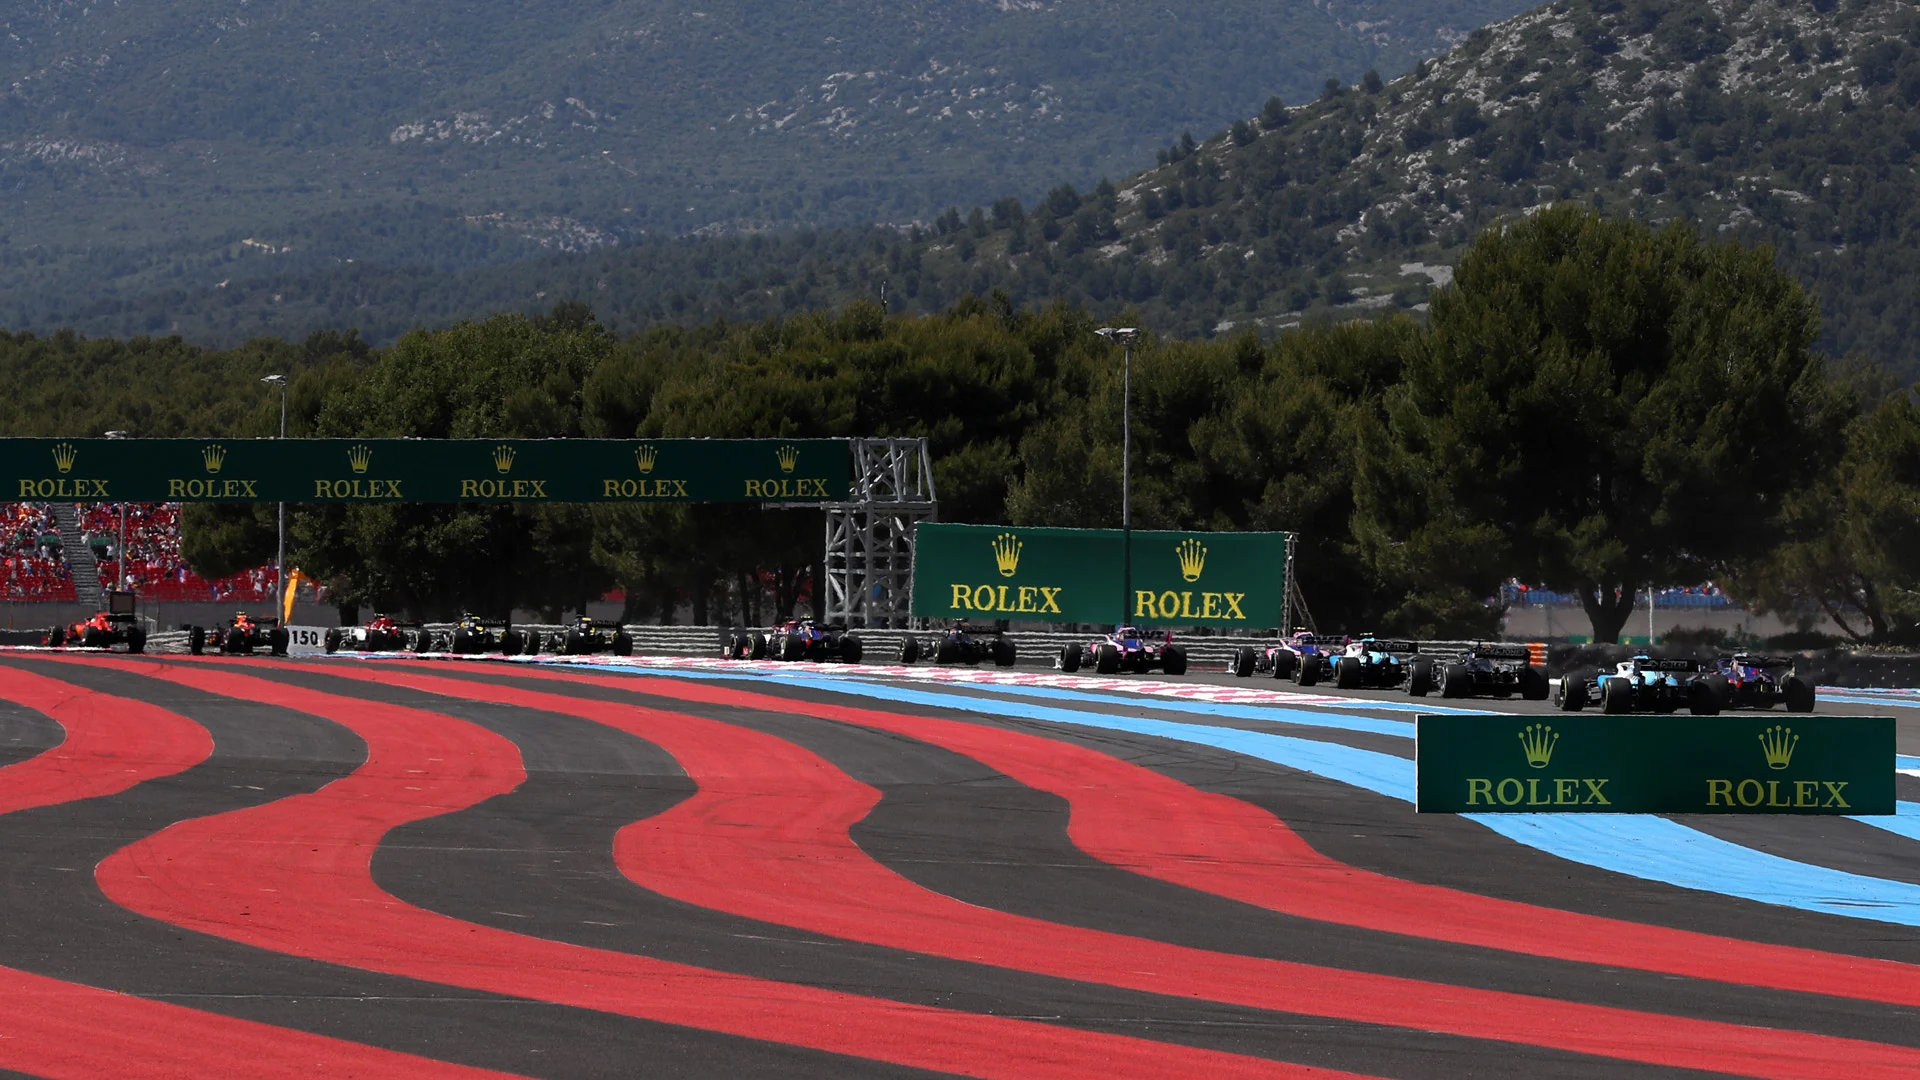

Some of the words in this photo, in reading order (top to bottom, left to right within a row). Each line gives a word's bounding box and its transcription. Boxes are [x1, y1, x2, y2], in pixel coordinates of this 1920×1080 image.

[19, 479, 109, 498] ROLEX
[168, 479, 257, 498] ROLEX
[315, 479, 402, 498] ROLEX
[460, 479, 547, 498] ROLEX
[603, 479, 688, 498] ROLEX
[744, 479, 829, 498] ROLEX
[950, 584, 1062, 614] ROLEX
[1135, 590, 1247, 620] ROLEX
[292, 630, 318, 646] 150
[1466, 778, 1612, 806] ROLEX
[1706, 779, 1851, 808] ROLEX
